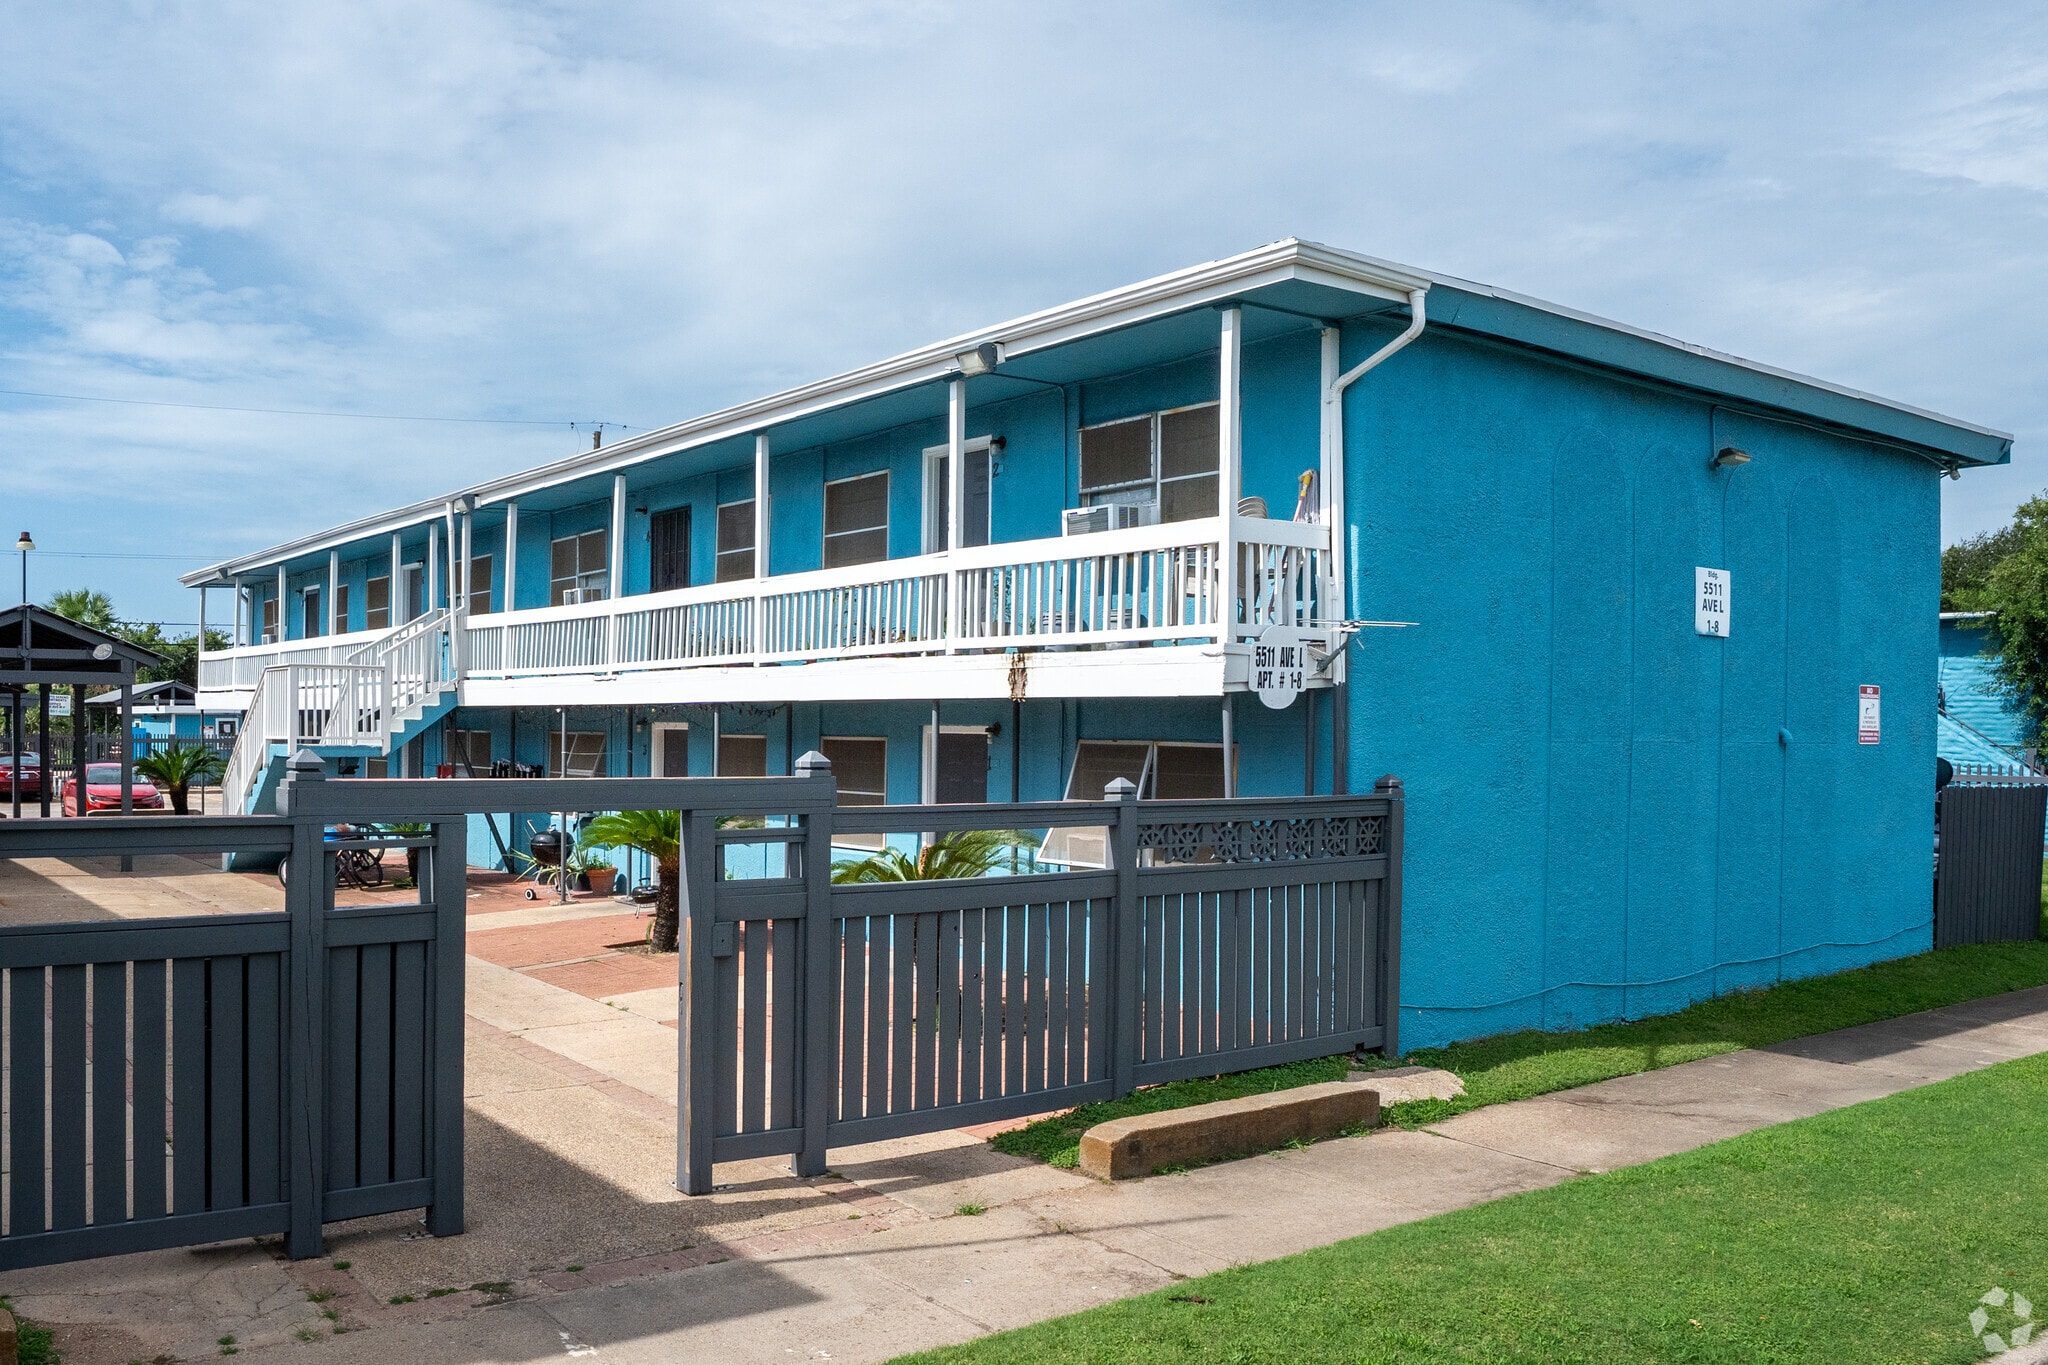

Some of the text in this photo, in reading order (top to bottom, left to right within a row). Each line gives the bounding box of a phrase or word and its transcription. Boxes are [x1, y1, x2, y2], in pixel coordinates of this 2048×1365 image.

[992, 462, 999, 478] 2
[1703, 581, 1722, 596] 5511
[1702, 598, 1724, 613] AVE L
[1707, 619, 1719, 633] 1-8
[1255, 646, 1304, 668] 5511 AVE L
[1256, 670, 1302, 689] APT. # 1-8
